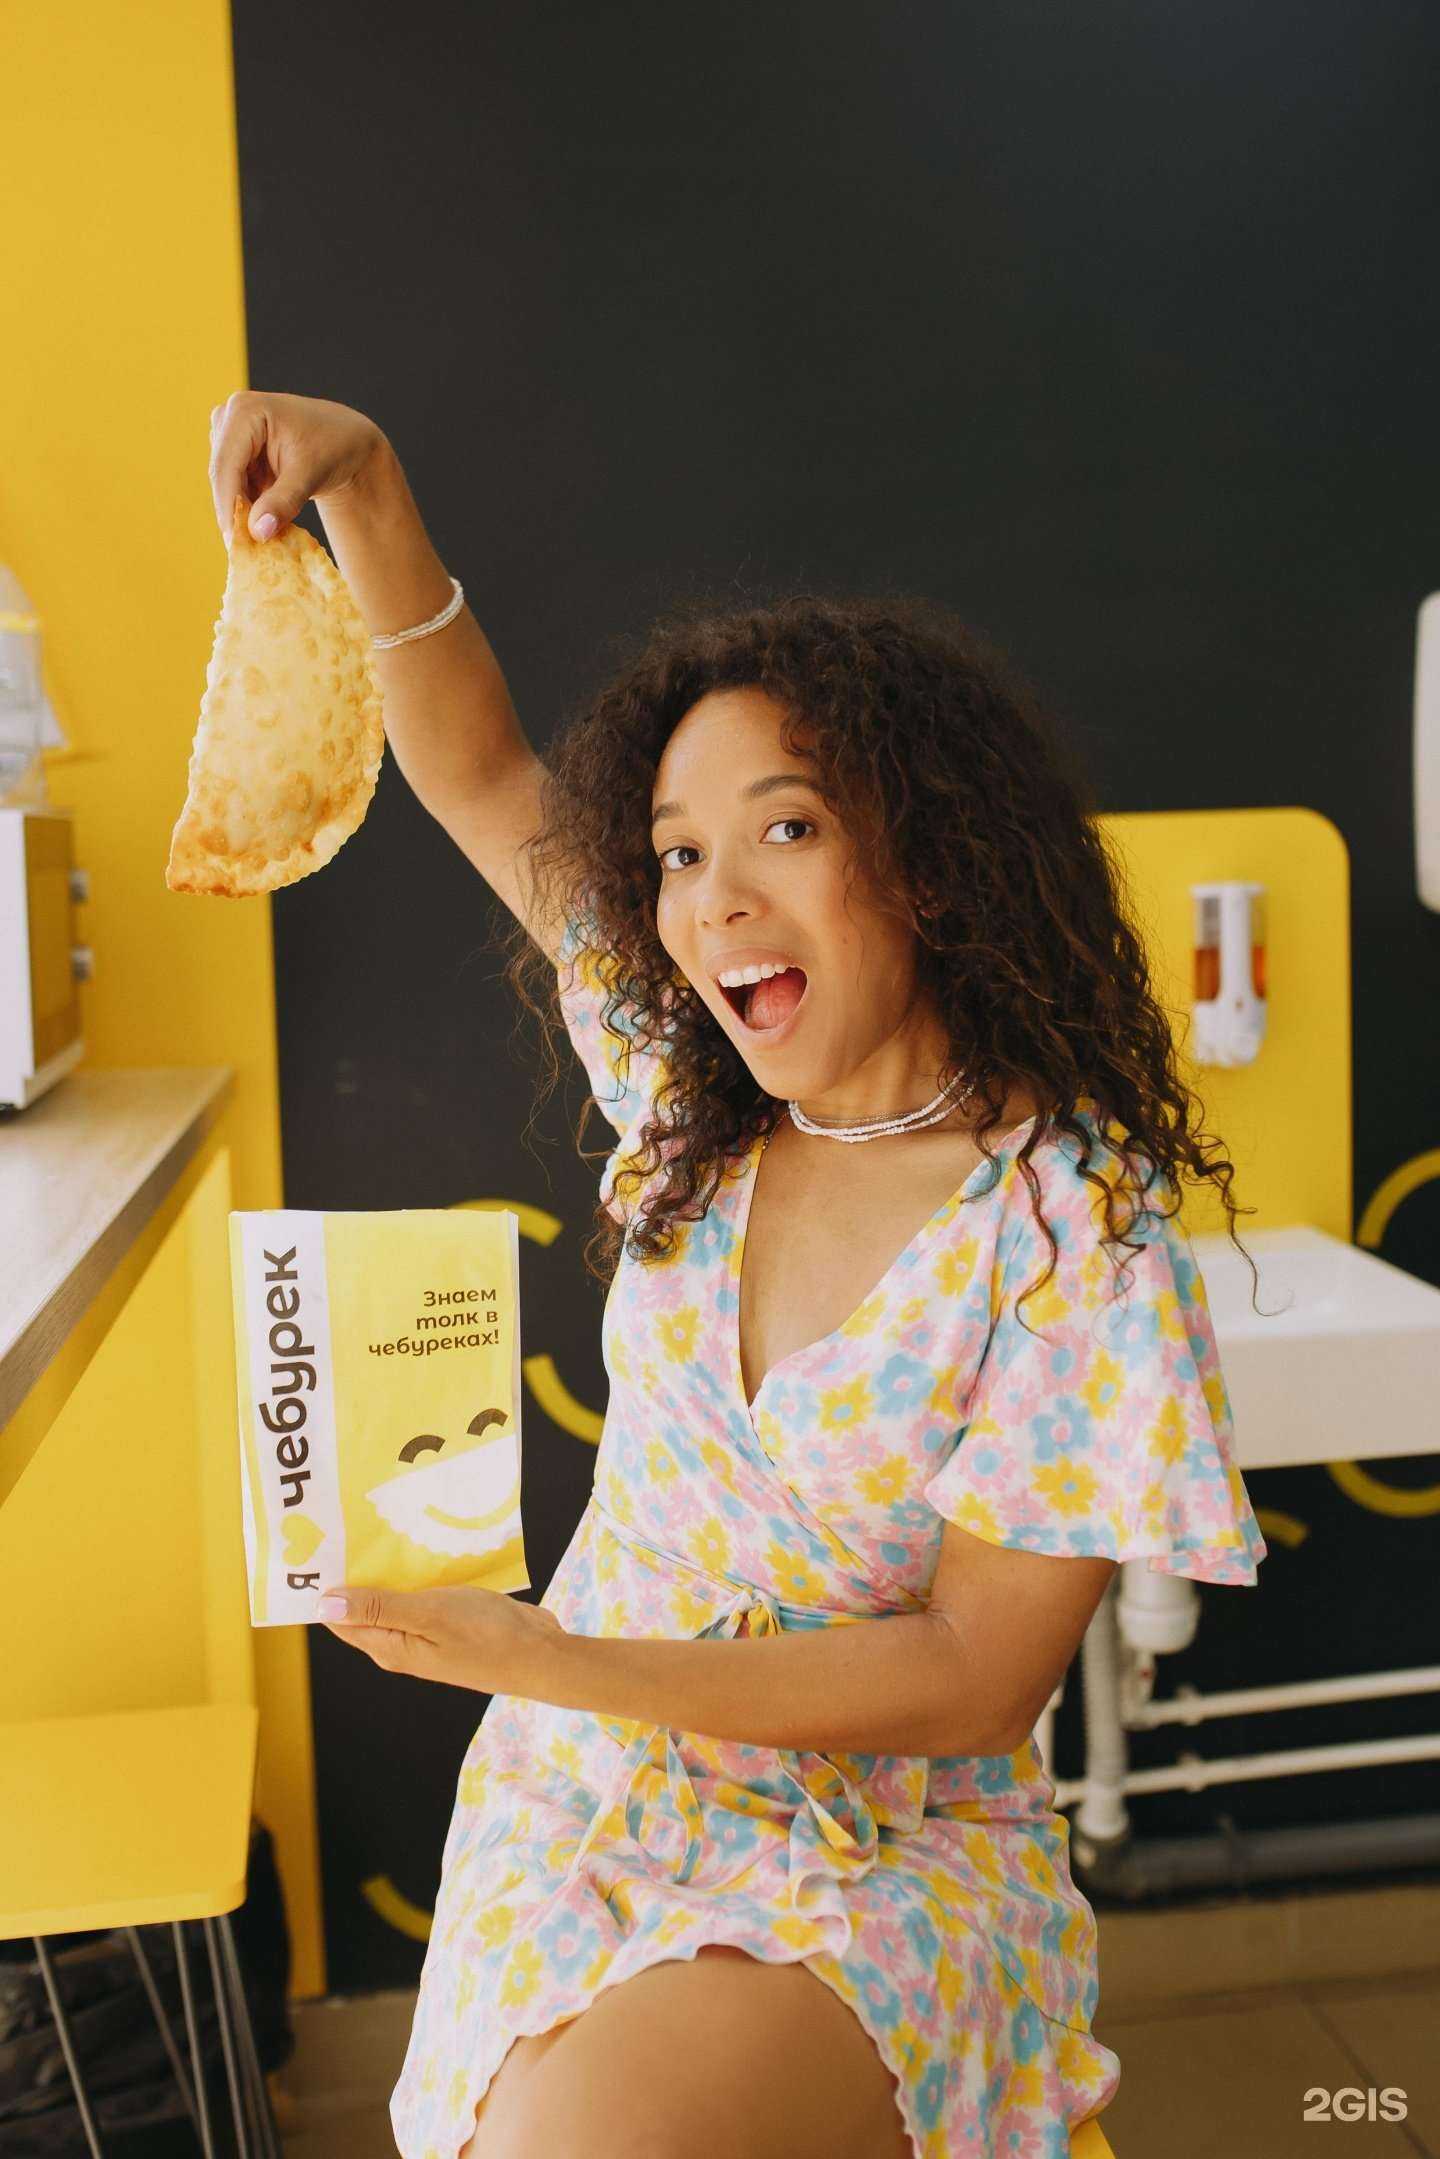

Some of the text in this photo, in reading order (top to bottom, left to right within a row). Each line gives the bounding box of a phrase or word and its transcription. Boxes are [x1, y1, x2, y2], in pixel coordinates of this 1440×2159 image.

[423, 1288, 497, 1307] Знаем
[416, 1311, 498, 1330] толк в
[368, 1329, 500, 1357] чебуреках!
[258, 1245, 317, 1508] чебурек
